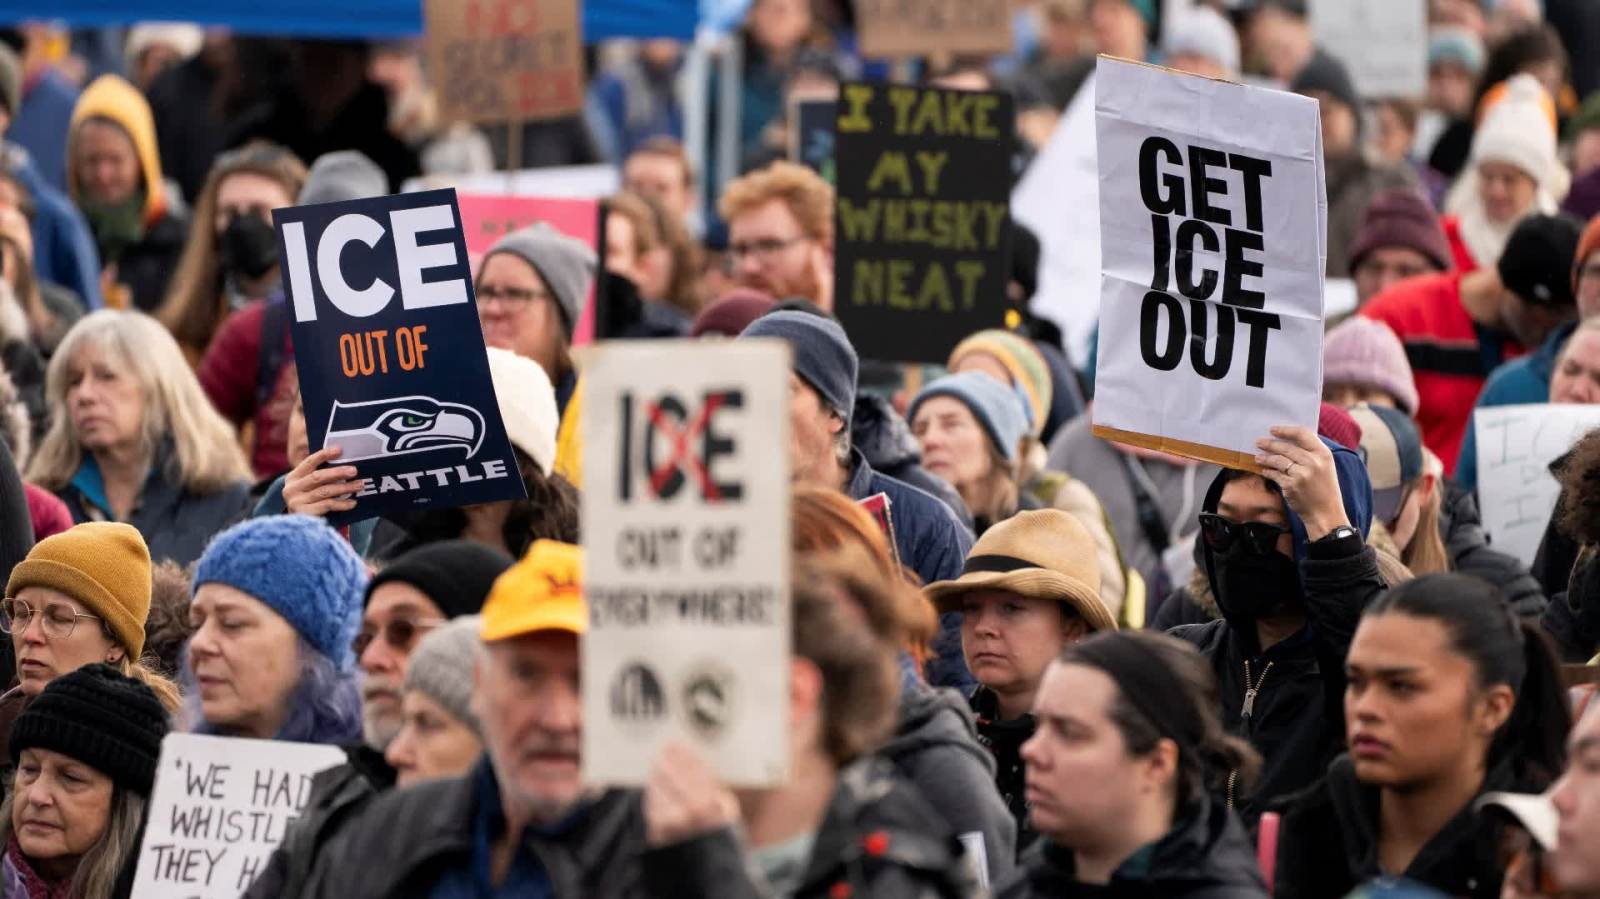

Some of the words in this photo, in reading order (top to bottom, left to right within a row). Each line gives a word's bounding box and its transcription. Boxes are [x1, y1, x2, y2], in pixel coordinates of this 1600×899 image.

[838, 84, 875, 132] I
[887, 87, 1000, 137] TAKE
[867, 151, 948, 194] MY
[1138, 136, 1273, 233] GET
[838, 197, 1006, 249] WHISKY
[281, 204, 469, 323] ICE
[851, 259, 985, 312] NEAT
[1150, 214, 1266, 310] ICE
[339, 328, 389, 379] OUT
[395, 325, 429, 371] OF
[1139, 291, 1282, 389] OUT
[619, 390, 744, 502] ICE
[151, 844, 227, 886] THEY
